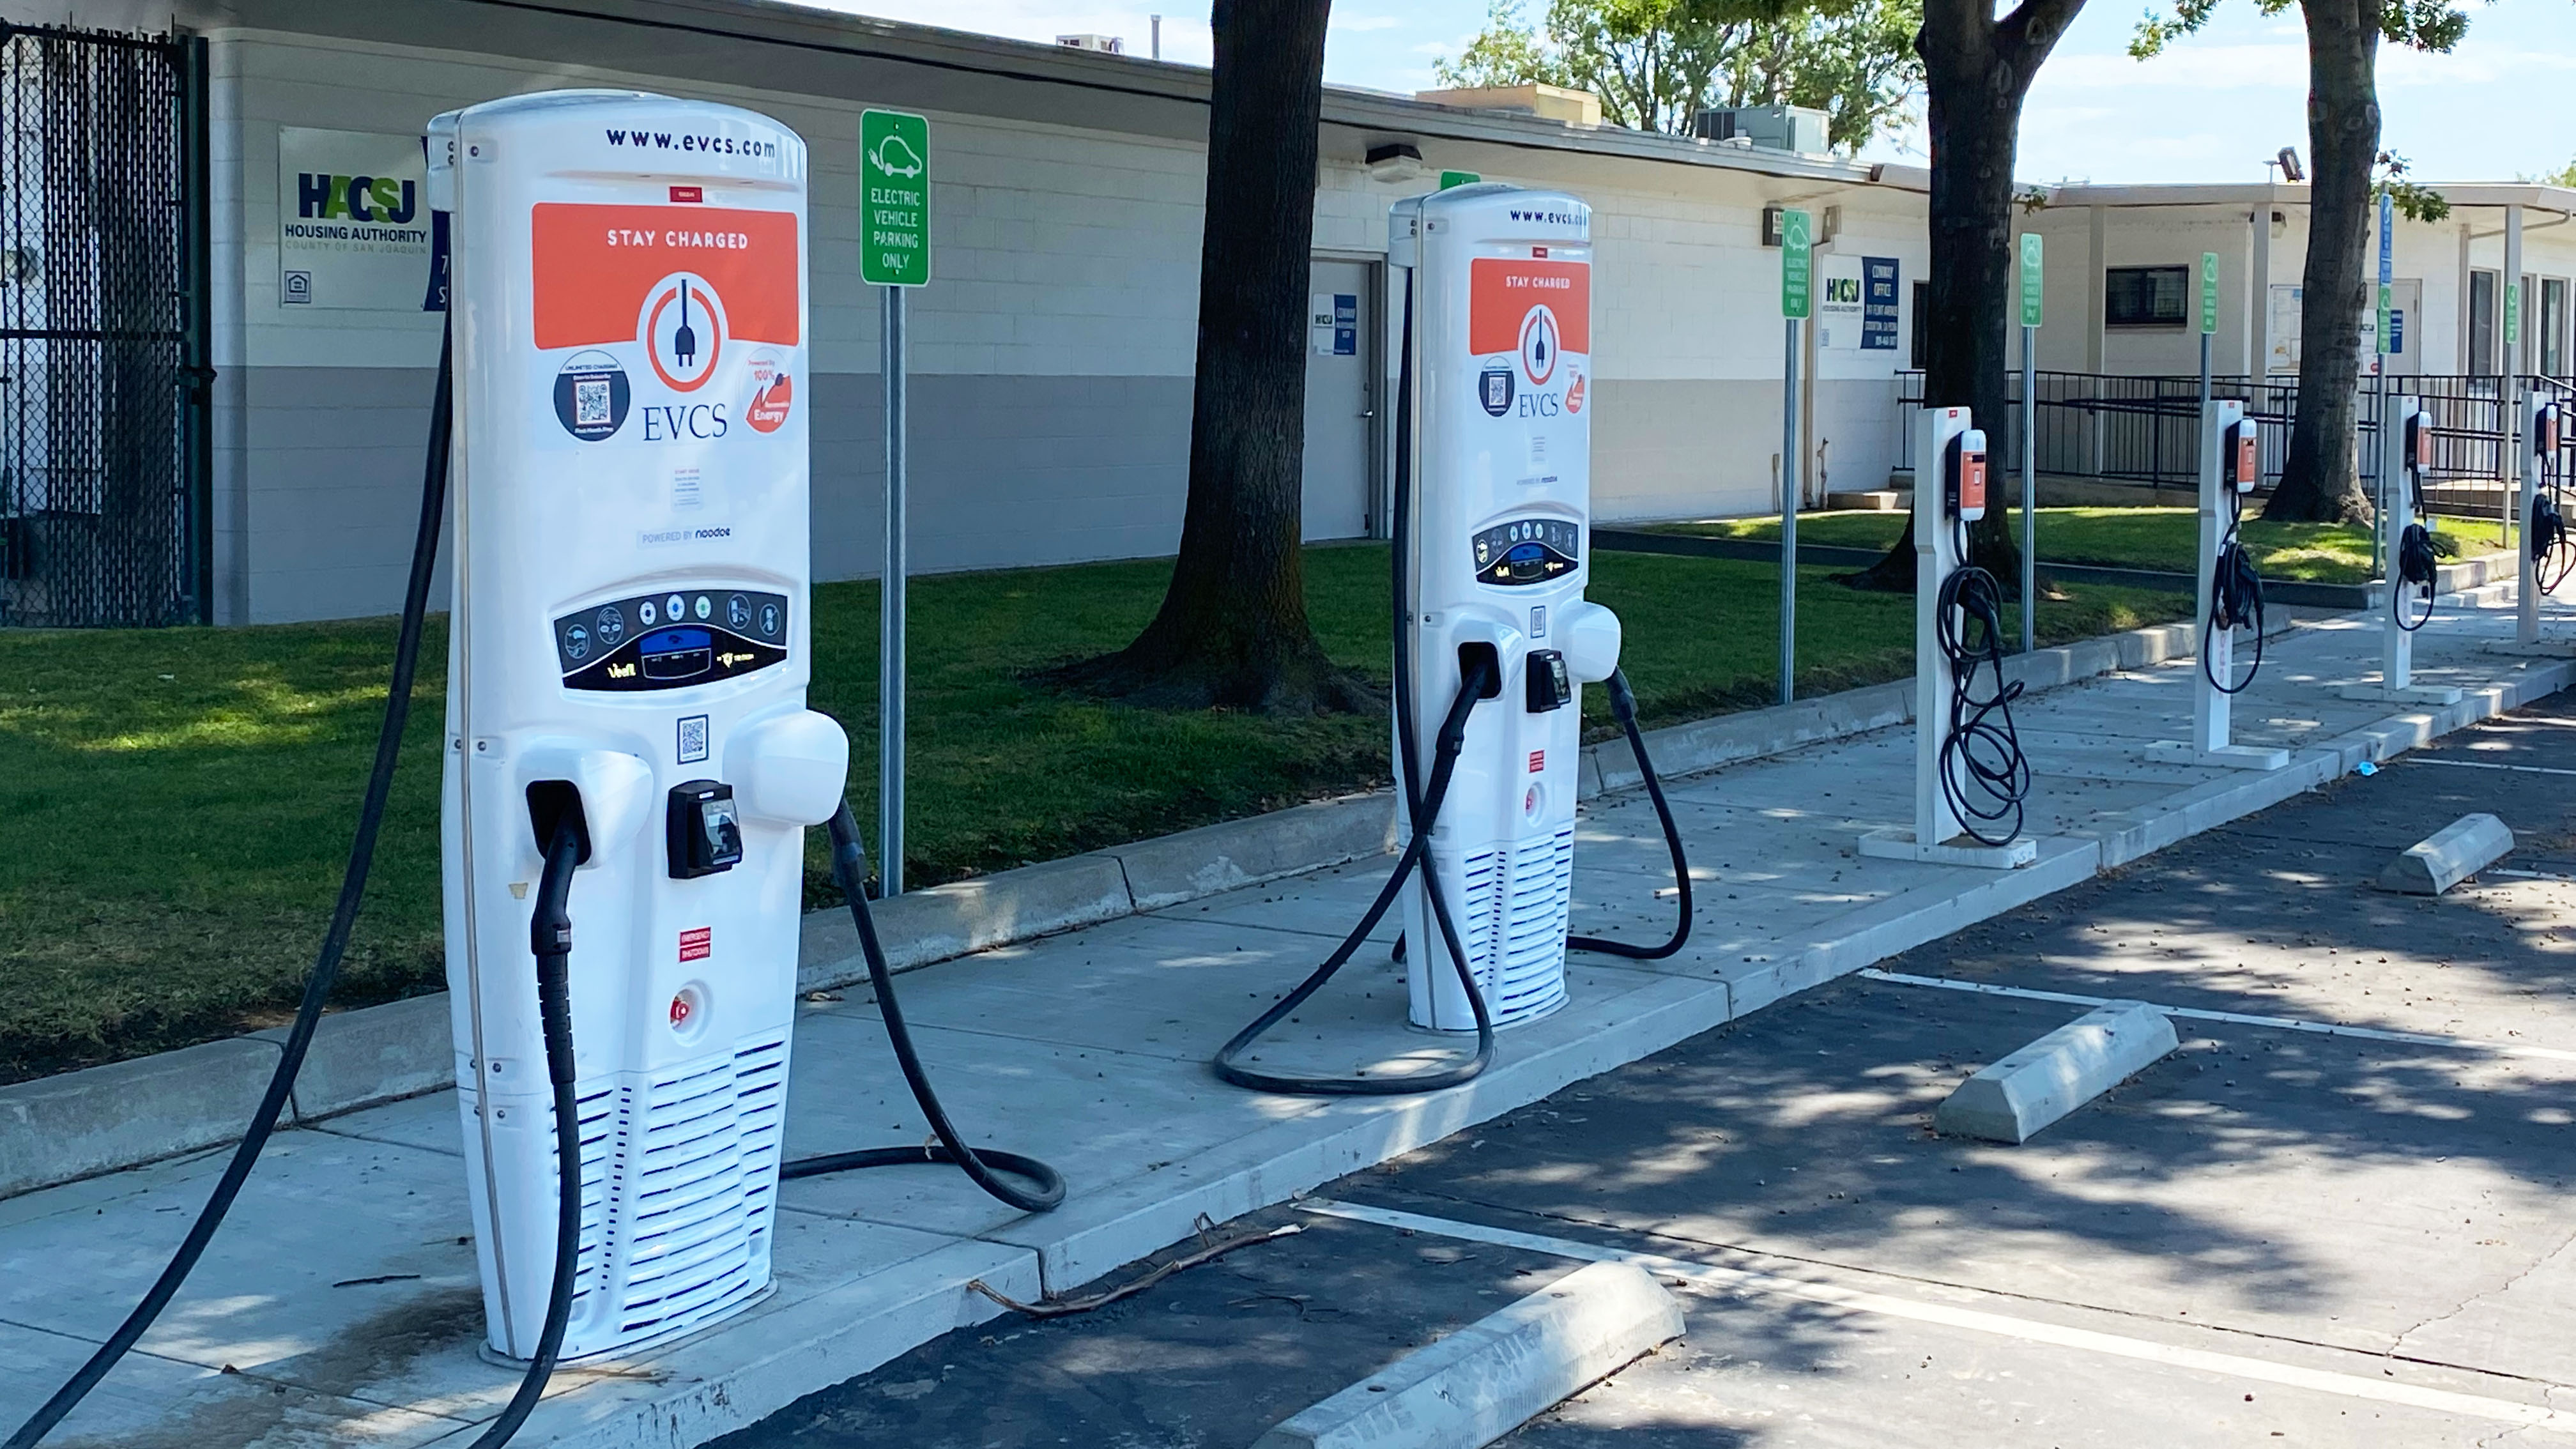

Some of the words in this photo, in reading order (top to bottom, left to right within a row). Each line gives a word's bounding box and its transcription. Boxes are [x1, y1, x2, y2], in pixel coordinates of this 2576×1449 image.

[606, 129, 776, 158] www.evcs.com
[298, 172, 415, 224] HACSJ
[871, 187, 921, 206] ELECTRIC
[873, 210, 918, 227] VEHICLE
[285, 224, 348, 239] HOUSING
[351, 227, 427, 243] AUTHORITY
[608, 229, 656, 247] STAY
[666, 231, 748, 249] CHARGED
[873, 231, 919, 249] PARKING
[285, 240, 330, 250] COUNTY
[335, 241, 347, 251] OF
[353, 242, 374, 252] SAN
[379, 243, 426, 254] JOAQUIN
[882, 252, 910, 268] ONLY
[1506, 275, 1529, 288] STAY
[1533, 276, 1570, 289] CHARGED
[754, 370, 775, 381] 100%
[1519, 393, 1559, 418] EVCS
[641, 403, 728, 441] EVCS
[754, 409, 783, 423] Energy
[643, 532, 681, 543] POWERED
[683, 531, 693, 541] BY
[695, 527, 730, 539] noodoe
